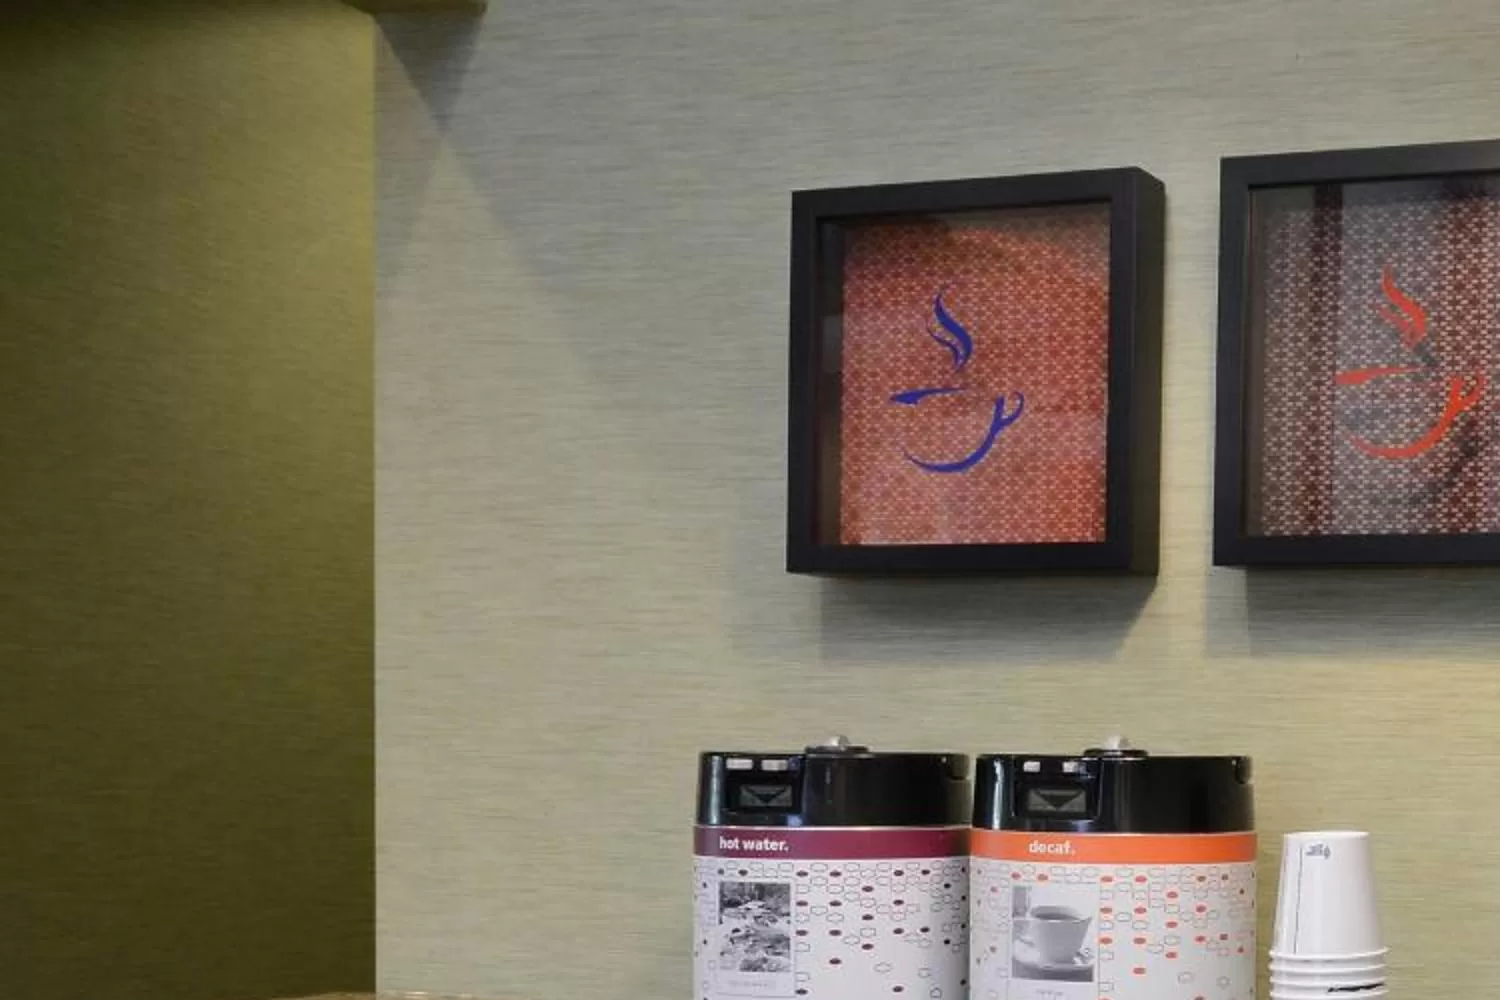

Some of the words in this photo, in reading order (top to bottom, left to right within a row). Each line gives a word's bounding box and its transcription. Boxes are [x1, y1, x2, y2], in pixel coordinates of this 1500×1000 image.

[719, 835, 740, 850] hot
[742, 837, 789, 852] water.
[1028, 839, 1076, 856] decaf.
